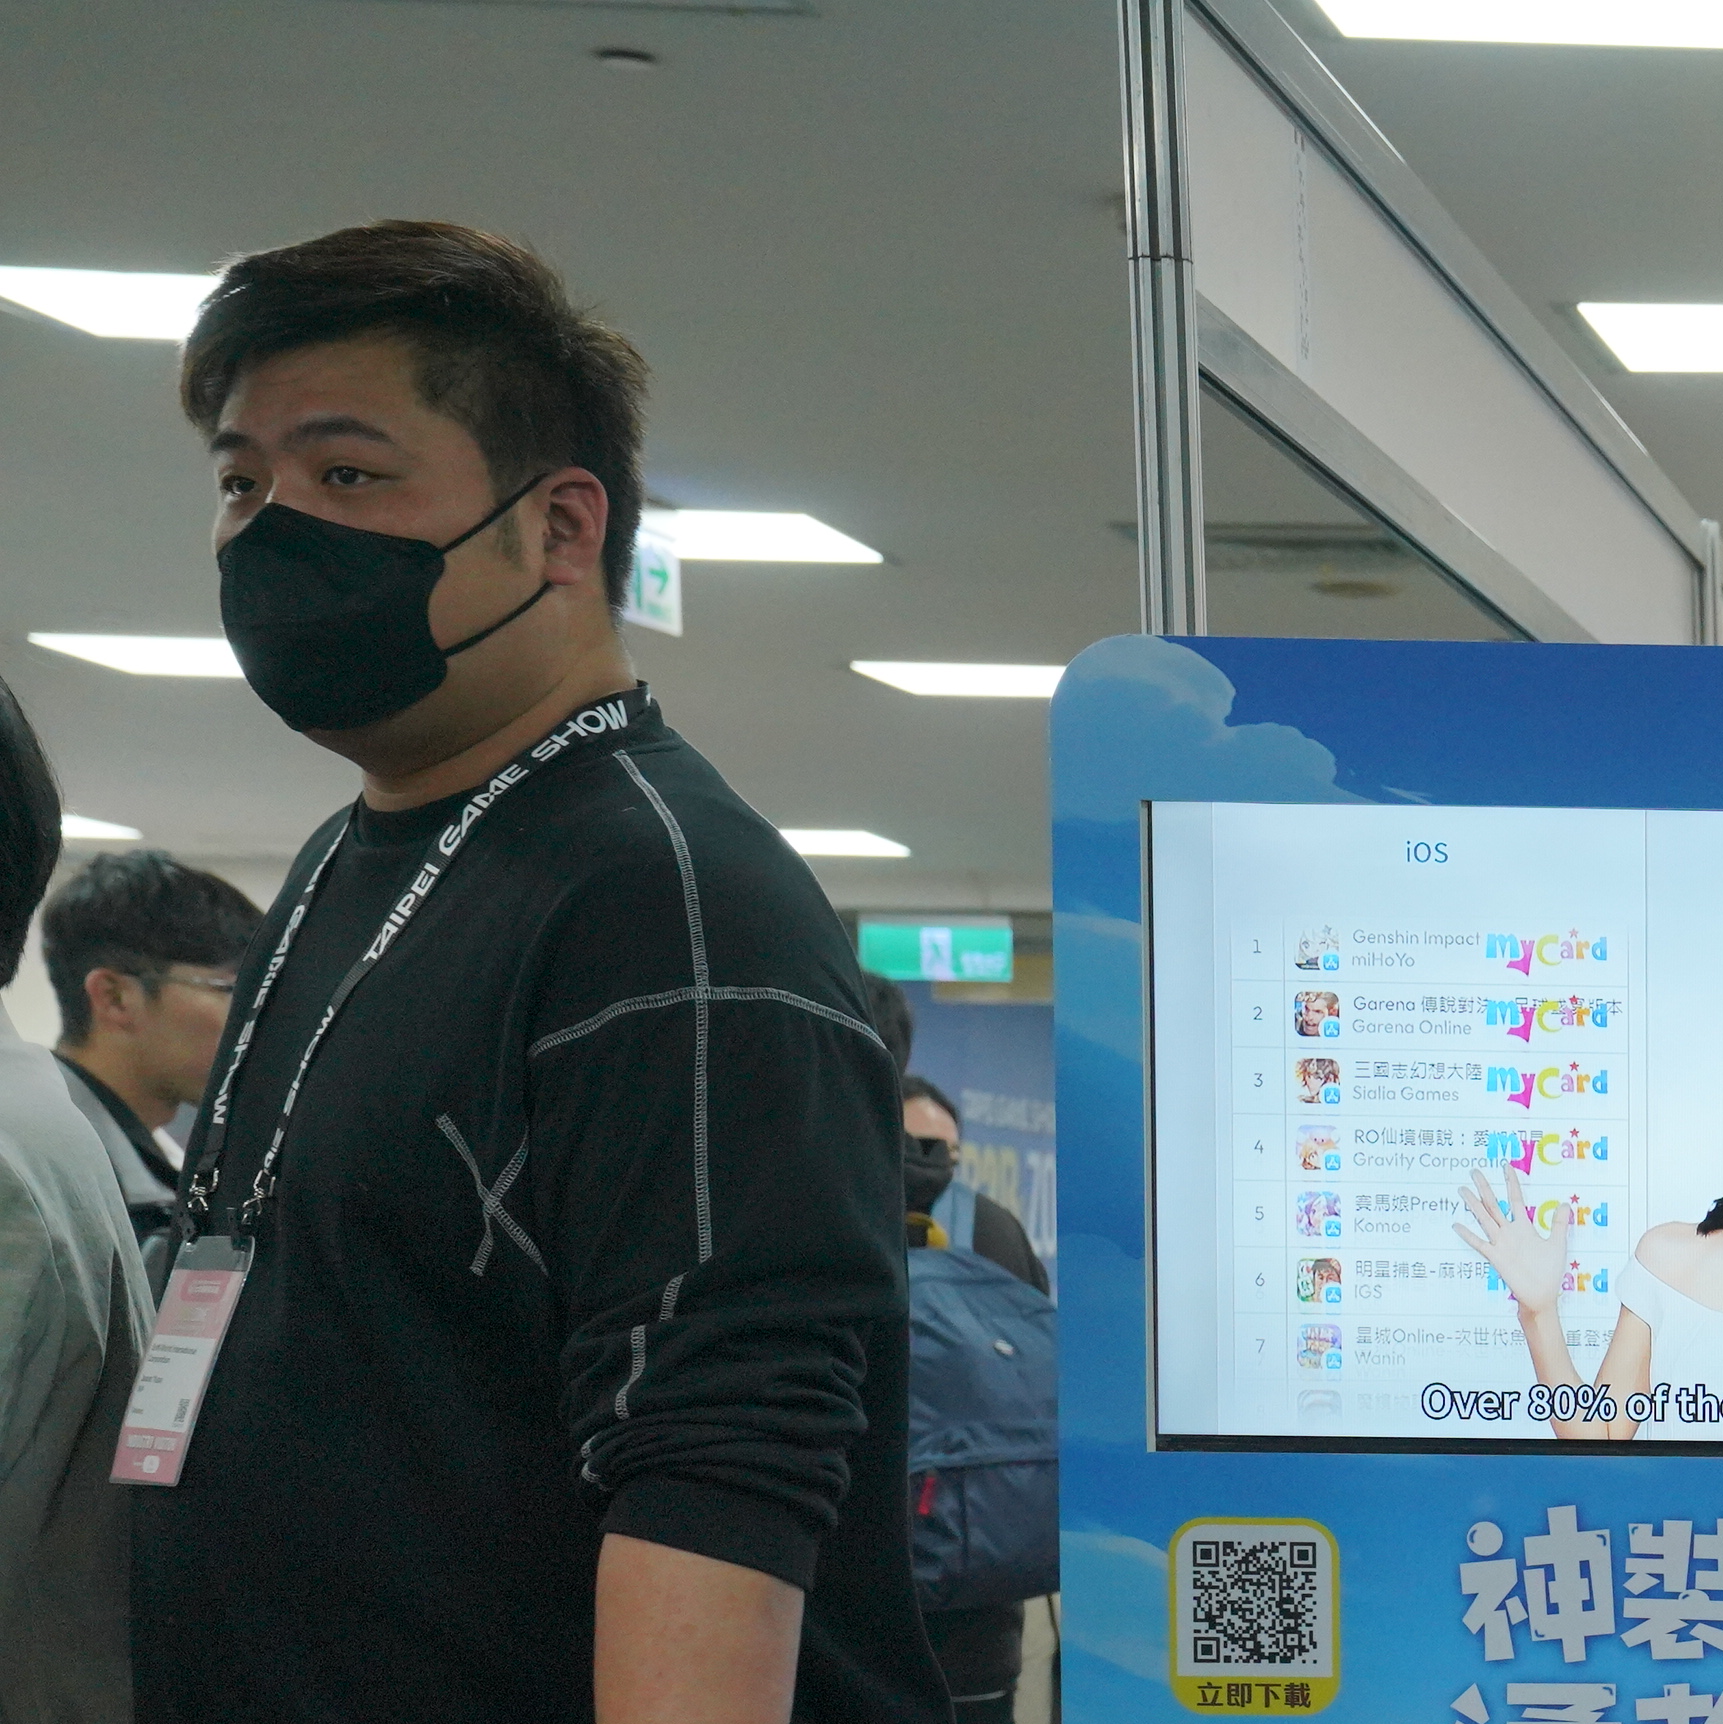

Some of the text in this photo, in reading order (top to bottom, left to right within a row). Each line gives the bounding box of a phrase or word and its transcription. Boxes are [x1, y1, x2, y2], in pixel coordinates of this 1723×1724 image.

[362, 700, 629, 962] TAIPEI GAME SHOW
[1405, 840, 1450, 865] iOS
[1252, 938, 1262, 954] 1
[1352, 928, 1481, 949] Genshin Impact
[1351, 951, 1416, 969] miHoYo
[1353, 995, 1416, 1012] Garena
[1252, 1005, 1264, 1022] 2
[1352, 1018, 1472, 1036] Garena Online
[1354, 1061, 1483, 1081] 三國志幻想大陸
[1253, 1072, 1265, 1089] 3
[1352, 1085, 1460, 1102] Sialia Games
[1253, 1138, 1265, 1155] 4
[1353, 1152, 1510, 1171] Gravity Corporatio
[1253, 1205, 1266, 1222] 5
[1353, 1218, 1411, 1234] Komoe
[1253, 1272, 1266, 1289] 6
[1354, 1284, 1383, 1299] IGS
[1254, 1338, 1266, 1355] 7
[1354, 1351, 1406, 1366] Wanin
[1420, 1382, 1521, 1423] Over
[1527, 1383, 1616, 1423] 80%
[1625, 1383, 1669, 1423] of
[1196, 1682, 1312, 1710] 立即下載
